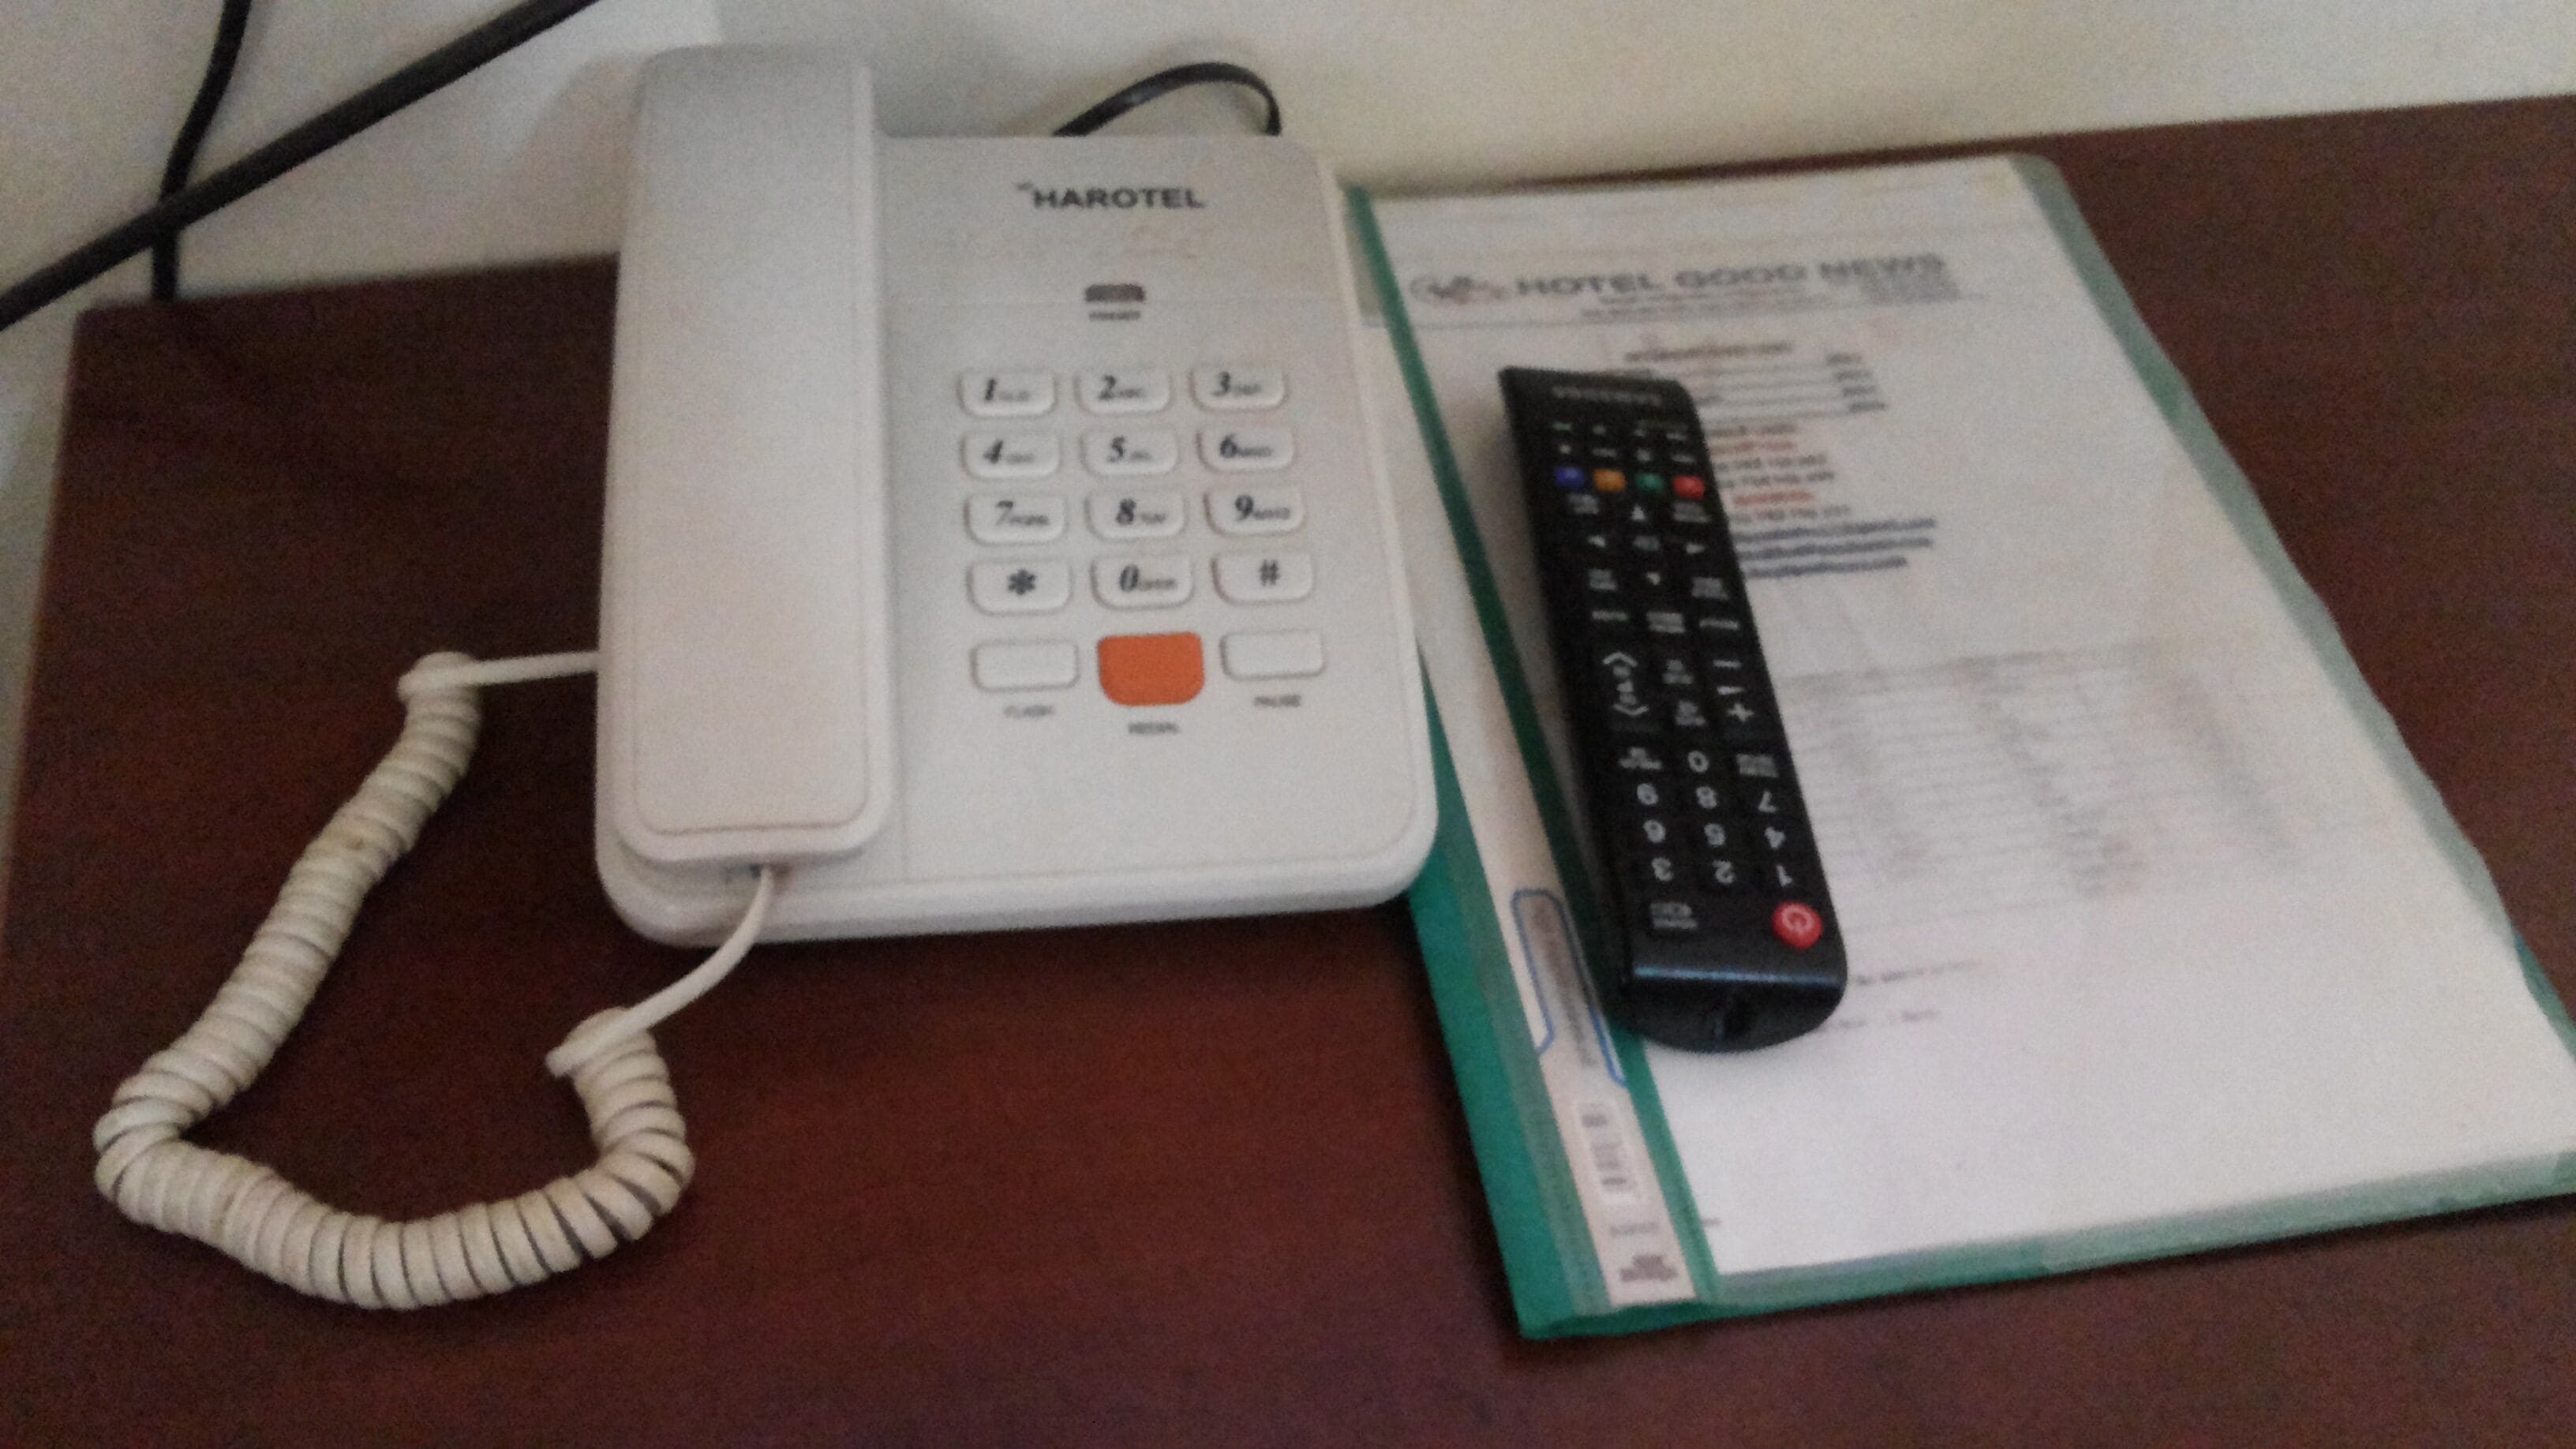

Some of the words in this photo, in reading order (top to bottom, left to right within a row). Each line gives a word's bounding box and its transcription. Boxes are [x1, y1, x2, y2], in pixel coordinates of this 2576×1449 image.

[1032, 186, 1206, 210] HAROTEL
[1515, 271, 1663, 298] HOTEL
[983, 376, 998, 402] 1
[1098, 374, 1118, 401] 2
[1211, 370, 1232, 397] 3
[983, 439, 1004, 464] 4
[1106, 435, 1126, 462] 5
[1219, 432, 1237, 459] 6
[995, 500, 1015, 526] 7
[1115, 498, 1137, 526] 8
[1234, 494, 1254, 522] 9
[1118, 564, 1140, 593] 0
[1259, 558, 1281, 586] #
[1695, 785, 1718, 811] 8
[1758, 790, 1777, 814] 7
[1651, 856, 1674, 882] 3
[1712, 859, 1735, 886] 2
[1776, 863, 1794, 888] 1
